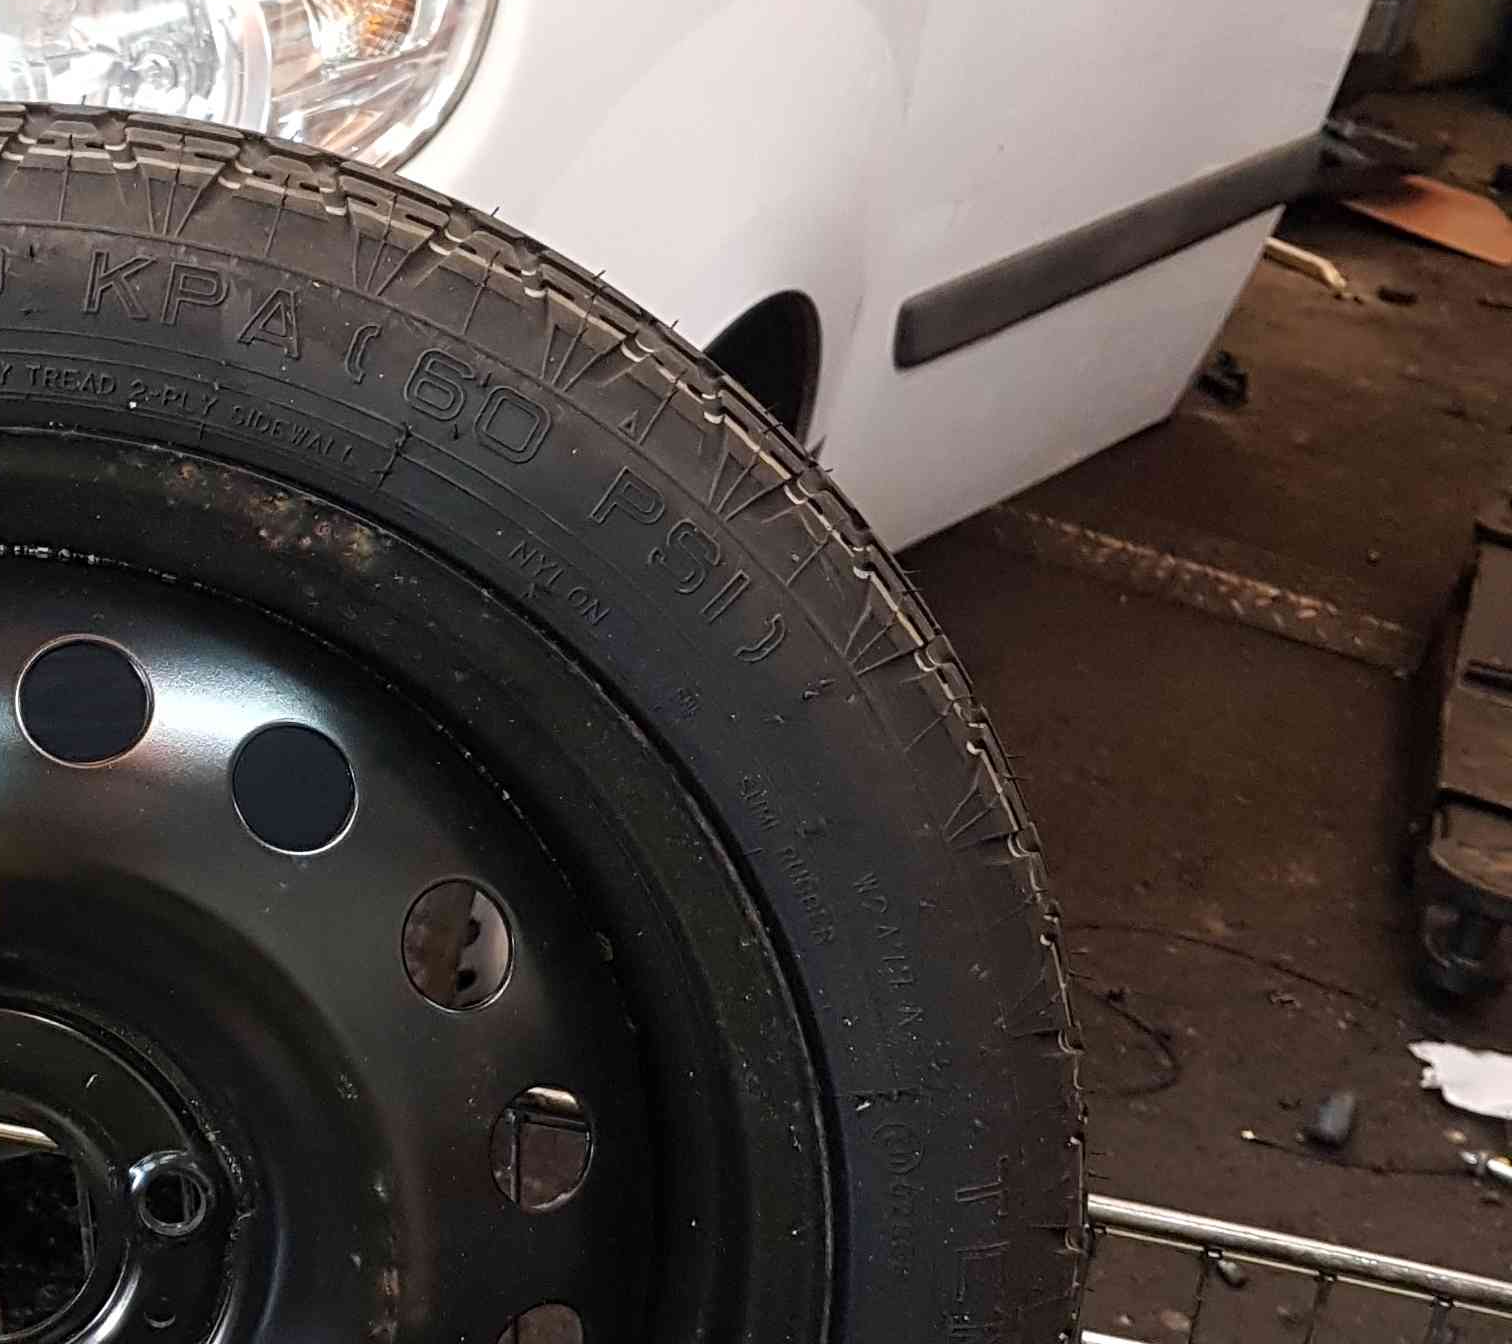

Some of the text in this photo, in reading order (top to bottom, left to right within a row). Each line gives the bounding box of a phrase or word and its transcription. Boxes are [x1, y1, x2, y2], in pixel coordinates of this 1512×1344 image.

[83, 247, 302, 359] KPA
[25, 364, 117, 396] TREAD
[129, 378, 218, 416] 2-PLY
[508, 538, 610, 628] NYLON
